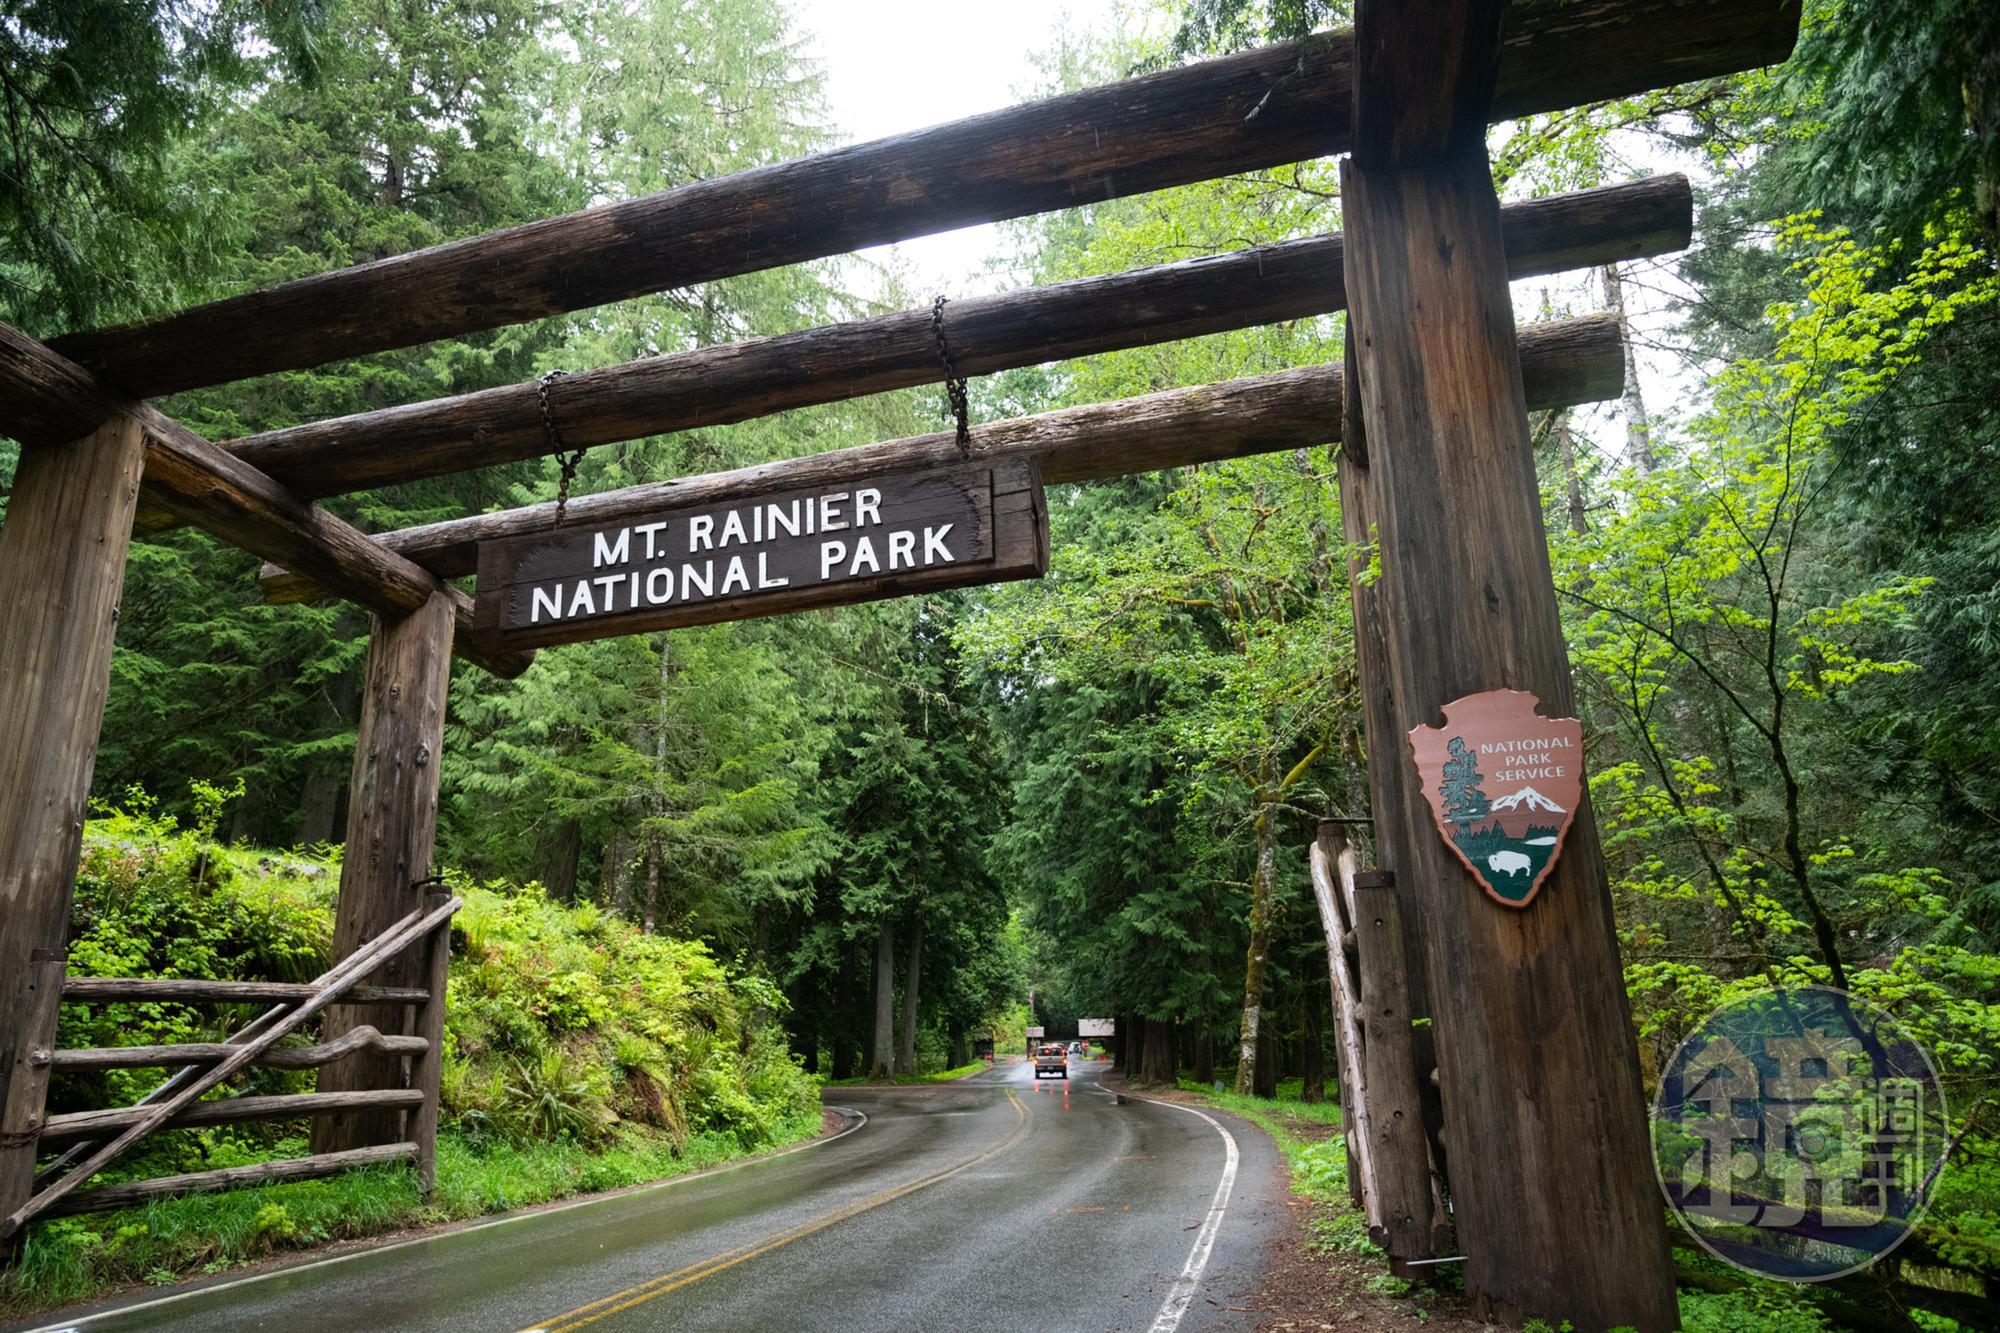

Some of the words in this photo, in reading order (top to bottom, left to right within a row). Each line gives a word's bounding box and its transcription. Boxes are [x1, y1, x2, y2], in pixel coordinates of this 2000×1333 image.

[594, 522, 666, 568] MT.
[690, 488, 882, 553] RAINIER
[531, 552, 789, 623] NATIONAL
[821, 523, 955, 580] PARK
[1481, 736, 1573, 754] NATIONAL
[1505, 753, 1551, 766] PARK
[1496, 766, 1565, 782] SERVICE
